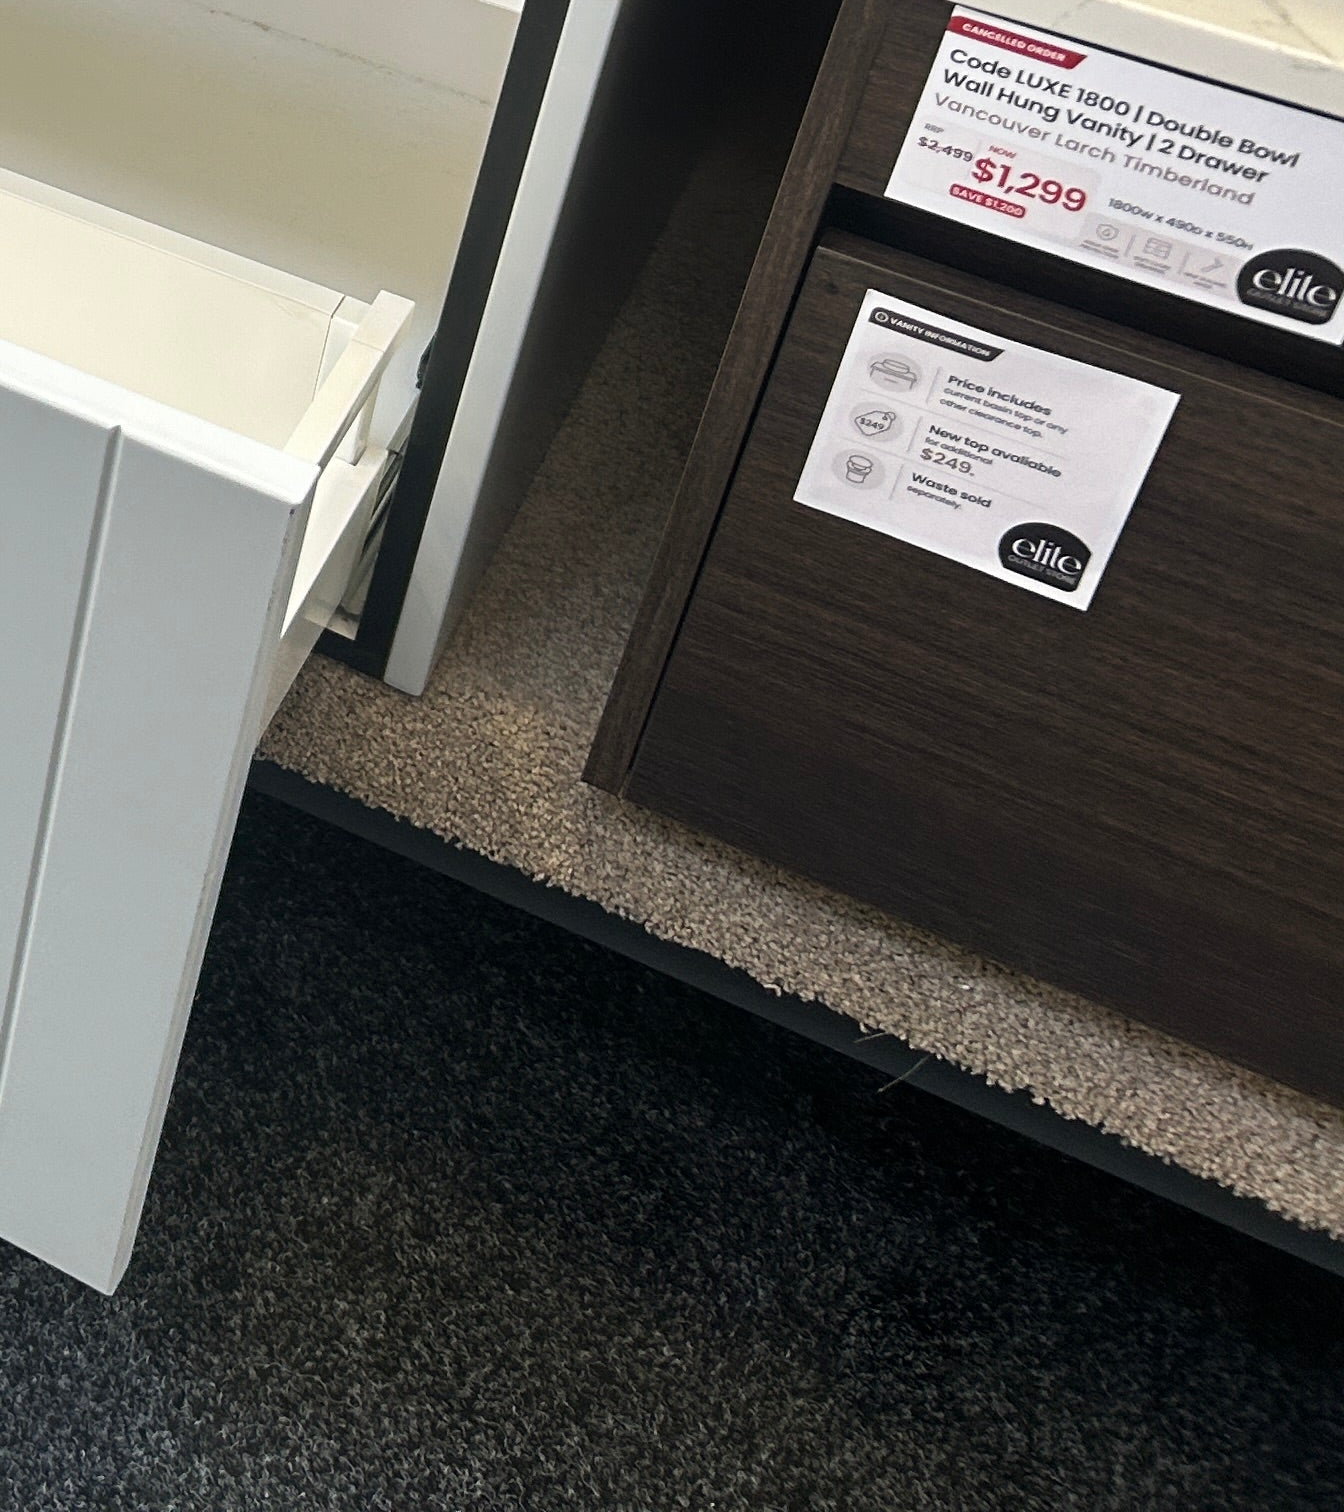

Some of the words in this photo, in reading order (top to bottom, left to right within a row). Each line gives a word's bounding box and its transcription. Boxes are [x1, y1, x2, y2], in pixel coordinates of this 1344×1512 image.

[962, 23, 1026, 50] CANCELLED
[1027, 43, 1066, 62] ORDER
[944, 69, 992, 97] Wall
[997, 87, 1060, 123] Hung
[1067, 109, 1144, 148] Vanity
[1160, 138, 1176, 155] 2
[1177, 144, 1270, 183] Drawer
[950, 49, 1011, 78] Code
[1016, 69, 1072, 99] LUXE
[1077, 87, 1130, 116] 1800
[1146, 111, 1233, 148] Double
[1238, 138, 1301, 168] Bowl
[917, 136, 973, 163] $2,499
[935, 93, 1051, 142] Vancouver
[1055, 134, 1116, 163] Larch
[1123, 154, 1256, 206] Timberland
[988, 145, 1017, 159] NOW
[952, 187, 981, 205] SAVE
[971, 157, 1087, 212] $1,299
[1253, 267, 1336, 307] elite
[890, 317, 924, 334] VANITY
[924, 330, 991, 357] INFORMATION
[944, 387, 981, 404] current
[1014, 410, 1033, 421] top
[1033, 417, 1046, 425] or
[1046, 422, 1069, 434] any
[948, 375, 985, 393] Price
[987, 387, 1052, 416] includes
[968, 408, 1022, 430] clearance
[929, 424, 962, 443] New
[964, 436, 989, 453] top
[940, 440, 993, 465] additional
[920, 447, 975, 477] $249.
[912, 472, 958, 496] Waste
[960, 491, 992, 509] sold
[1011, 538, 1082, 576] elite
